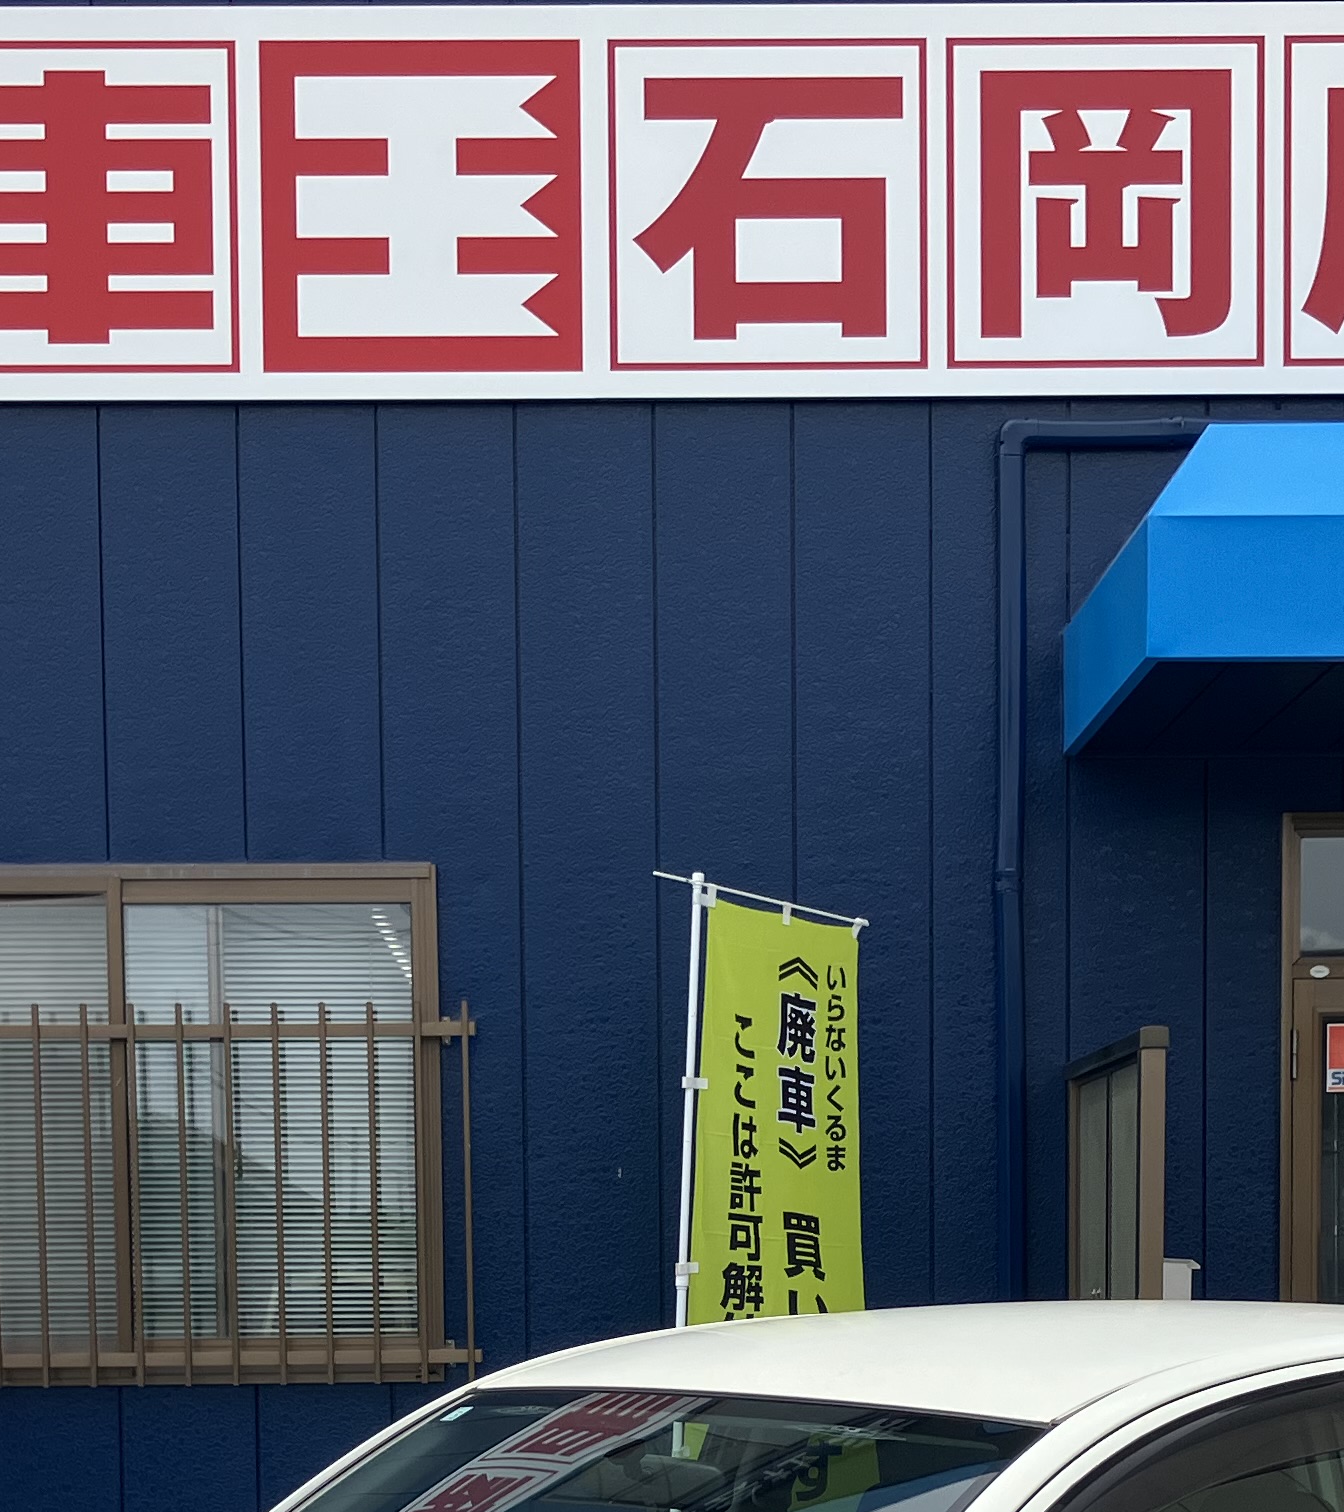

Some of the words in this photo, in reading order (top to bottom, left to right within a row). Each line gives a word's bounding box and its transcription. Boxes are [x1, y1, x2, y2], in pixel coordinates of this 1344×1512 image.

[718, 1012, 765, 1321] ここは許可解
[824, 964, 848, 1172] いらないくるま
